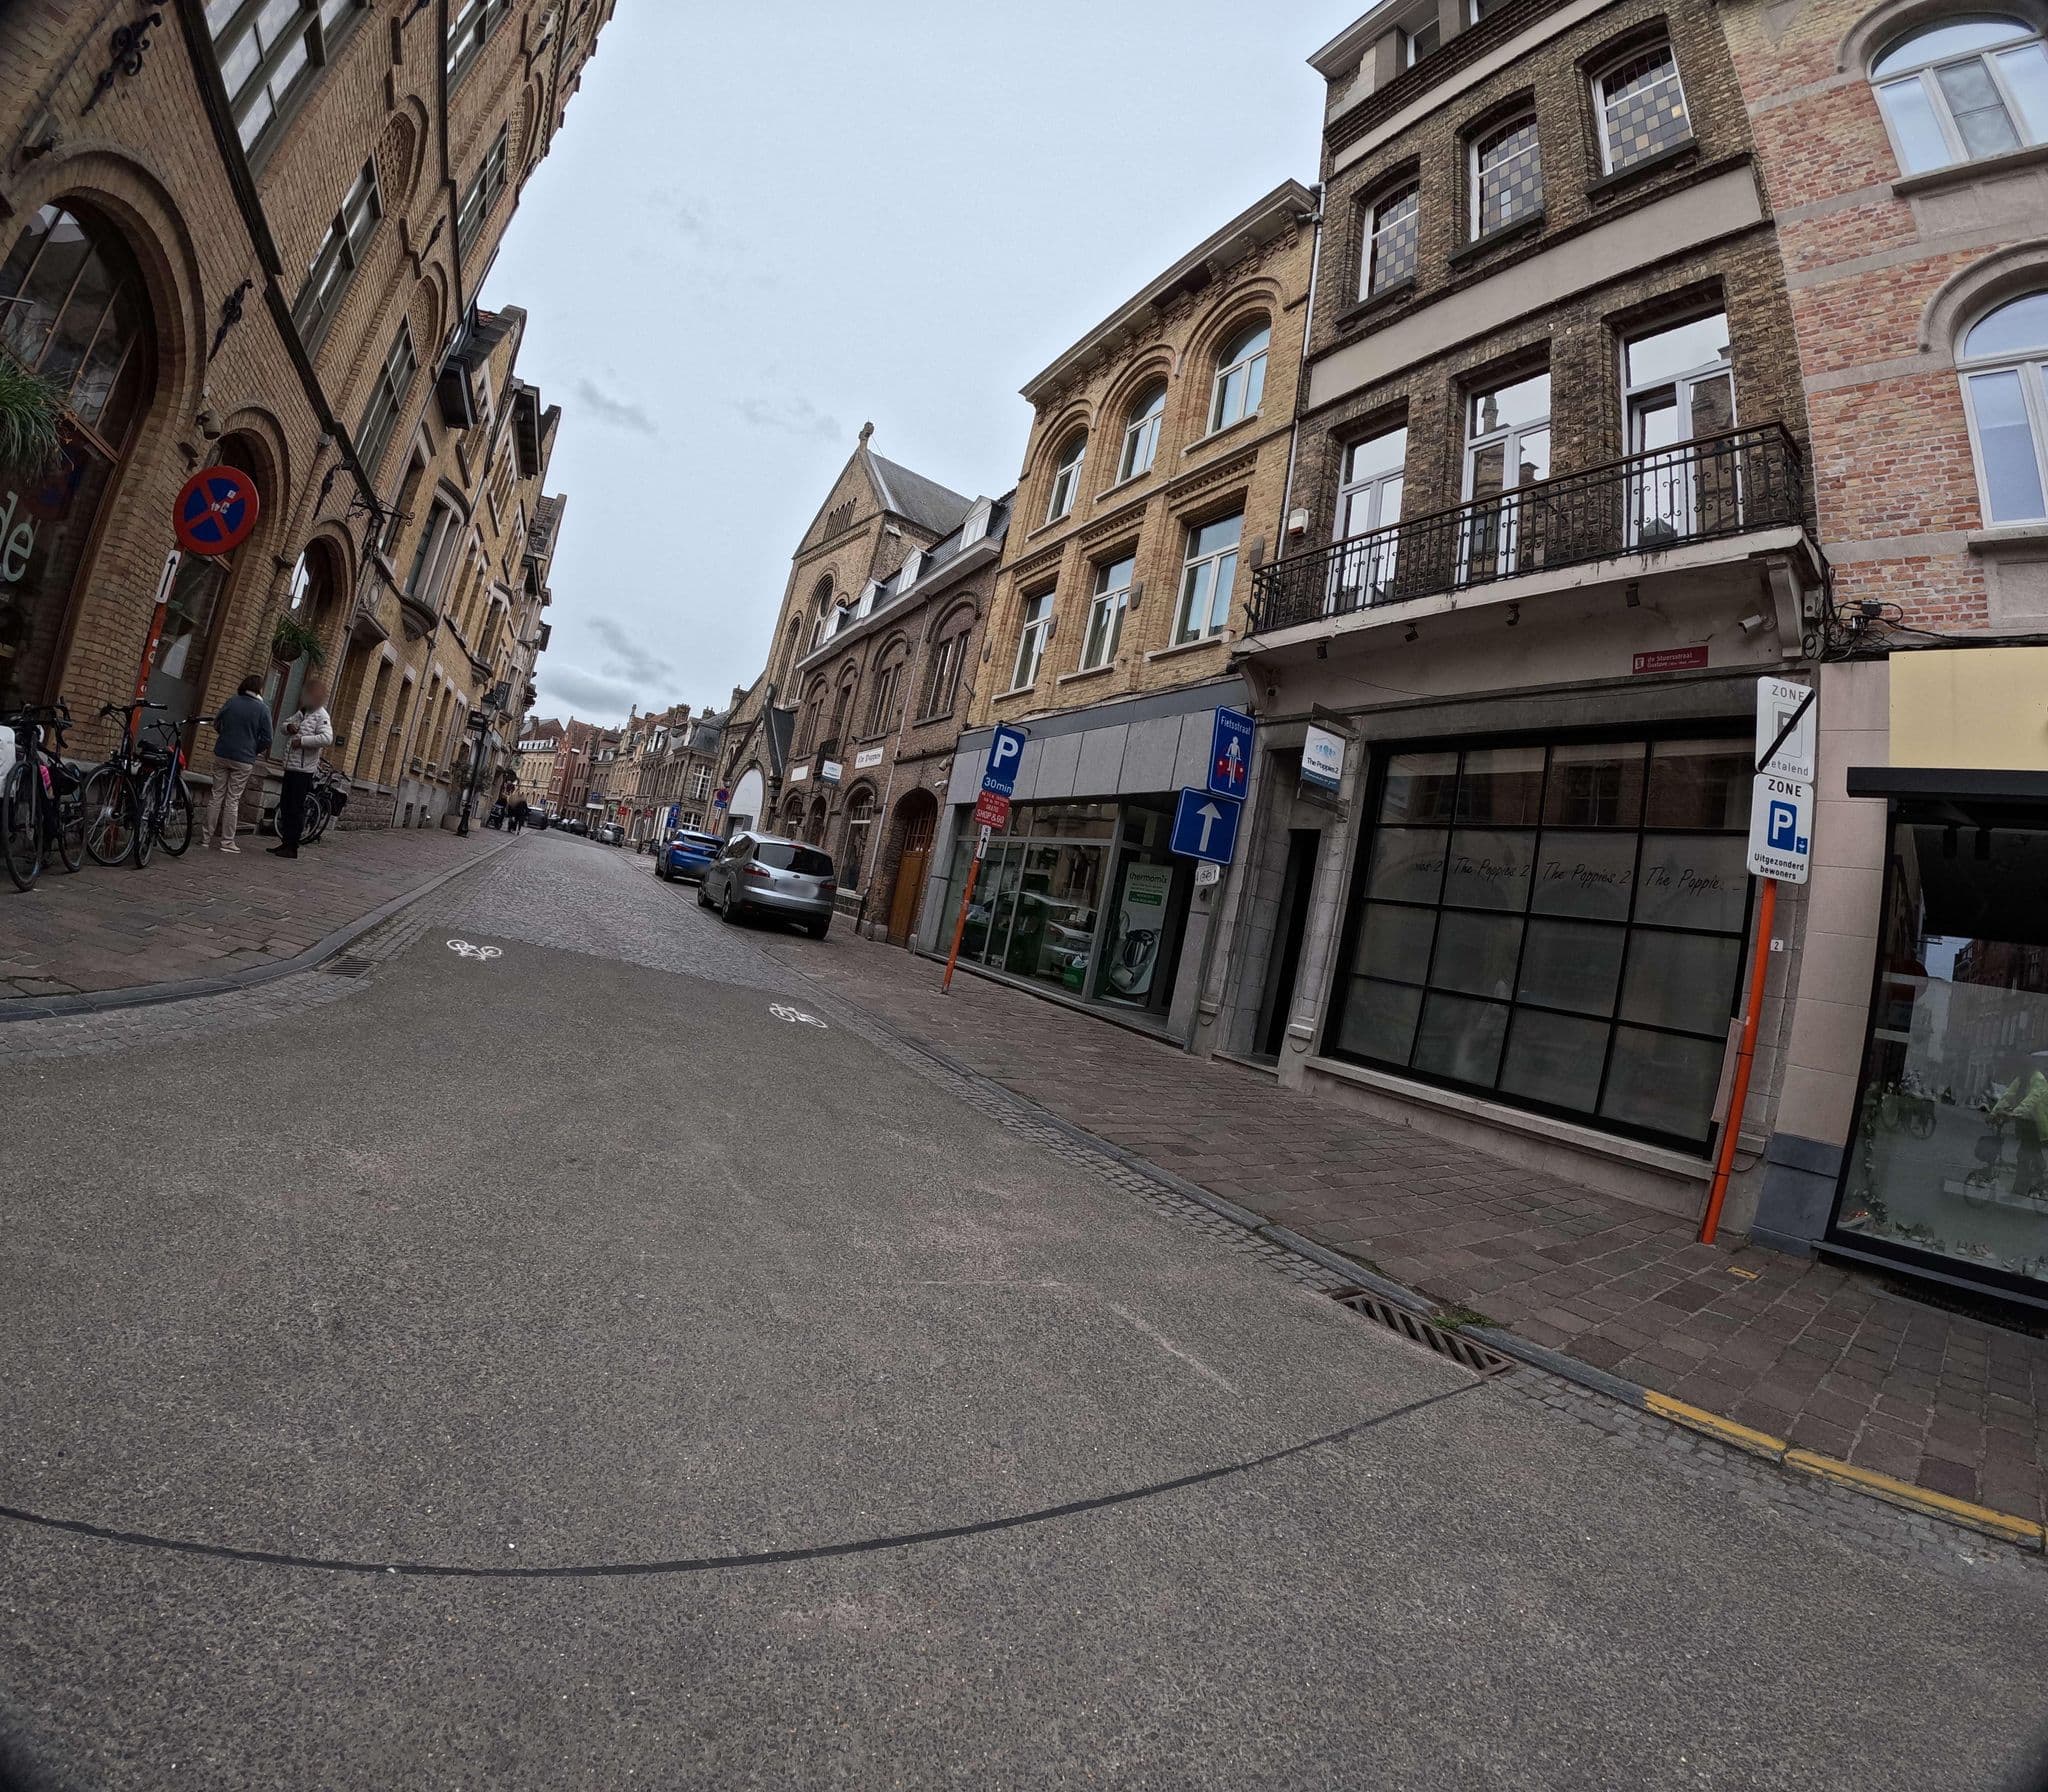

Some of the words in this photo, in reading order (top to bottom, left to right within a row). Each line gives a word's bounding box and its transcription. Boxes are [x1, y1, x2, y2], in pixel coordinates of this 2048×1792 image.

[1771, 684, 1805, 702] ZONE
[1220, 715, 1251, 736] Fietsstraat
[993, 734, 1019, 768] P
[1306, 757, 1316, 767] The
[1766, 760, 1809, 776] etalend
[1767, 779, 1802, 798] ZONE
[1772, 807, 1794, 840] P
[1453, 857, 1473, 874] The
[1519, 864, 1531, 878] 2
[1754, 852, 1805, 871] Uitgezonderd
[1543, 862, 1565, 880] The
[1571, 863, 1617, 889] Poppies
[1618, 870, 1632, 884] 2
[1646, 866, 1671, 887] The
[1760, 864, 1797, 880] bewoners
[1774, 941, 1780, 951] 2
